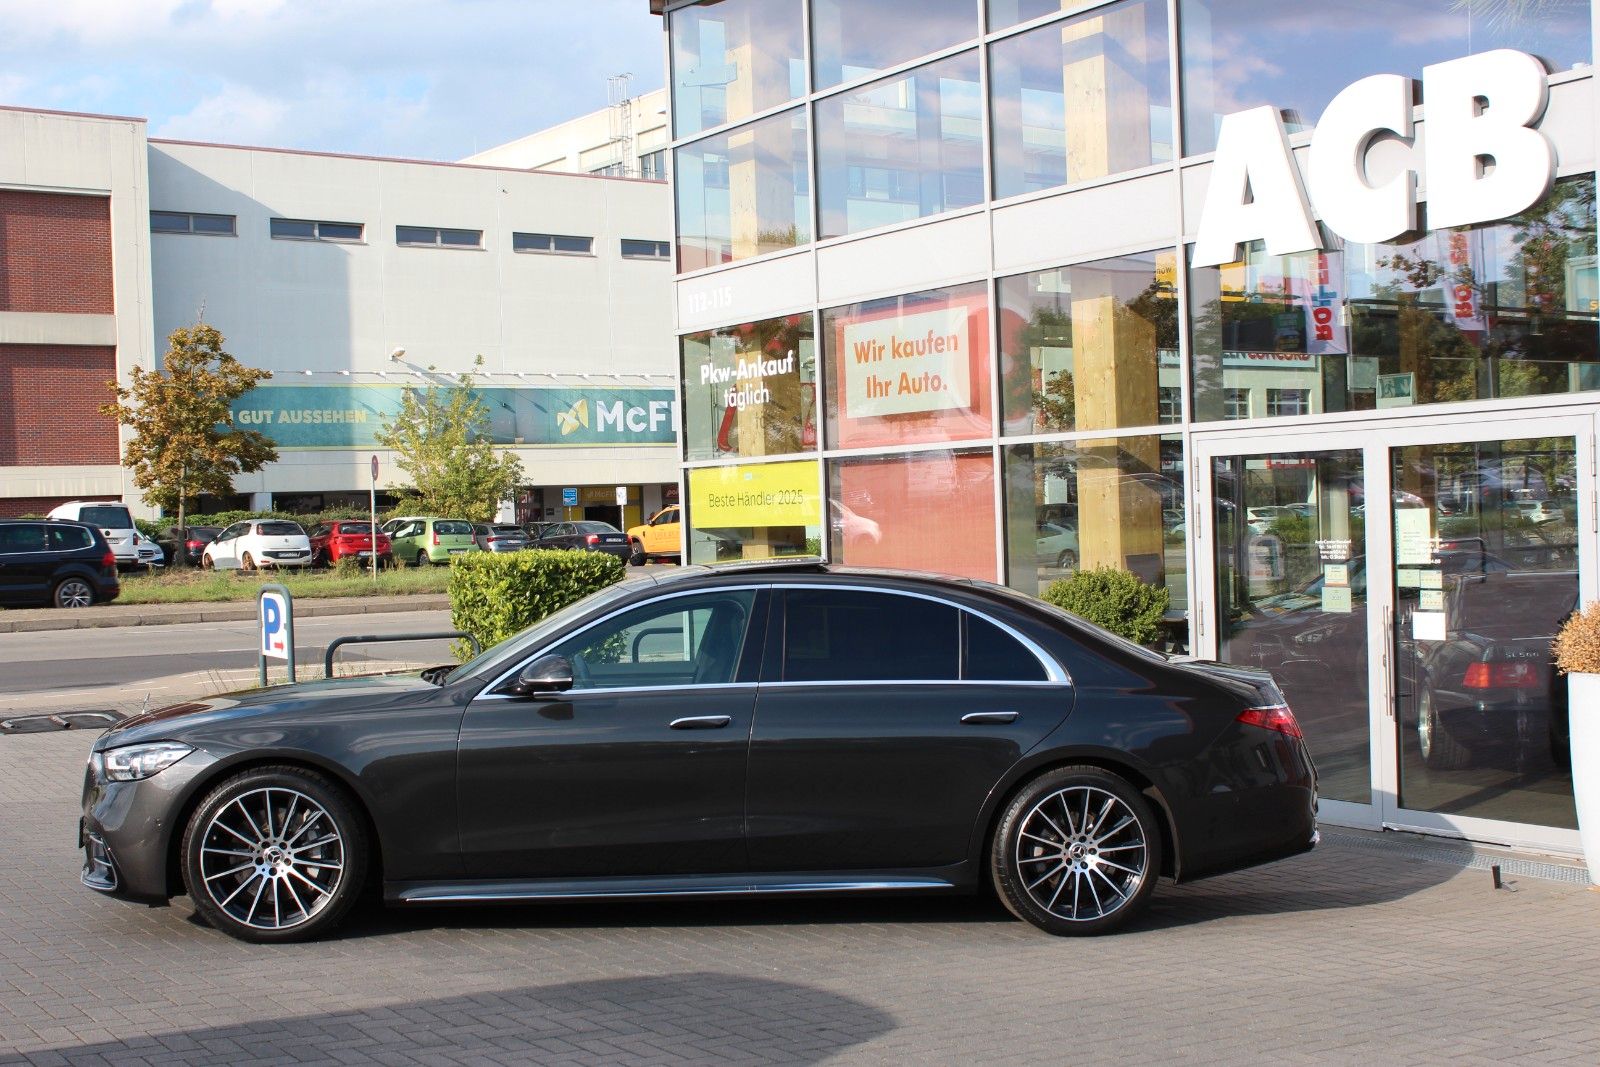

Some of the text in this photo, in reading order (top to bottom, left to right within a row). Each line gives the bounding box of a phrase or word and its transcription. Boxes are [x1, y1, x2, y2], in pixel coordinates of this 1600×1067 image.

[1190, 48, 1558, 269] ACB
[854, 330, 959, 364] Wir kaufen
[700, 350, 794, 385] Pkw-Ankauf
[724, 385, 770, 411] täglich
[866, 371, 948, 399] Ihr Auto.
[238, 410, 274, 424] GUT
[277, 410, 368, 424] AUSSEHEN
[708, 489, 804, 508] Beste Händler 2025
[263, 597, 281, 650] P
